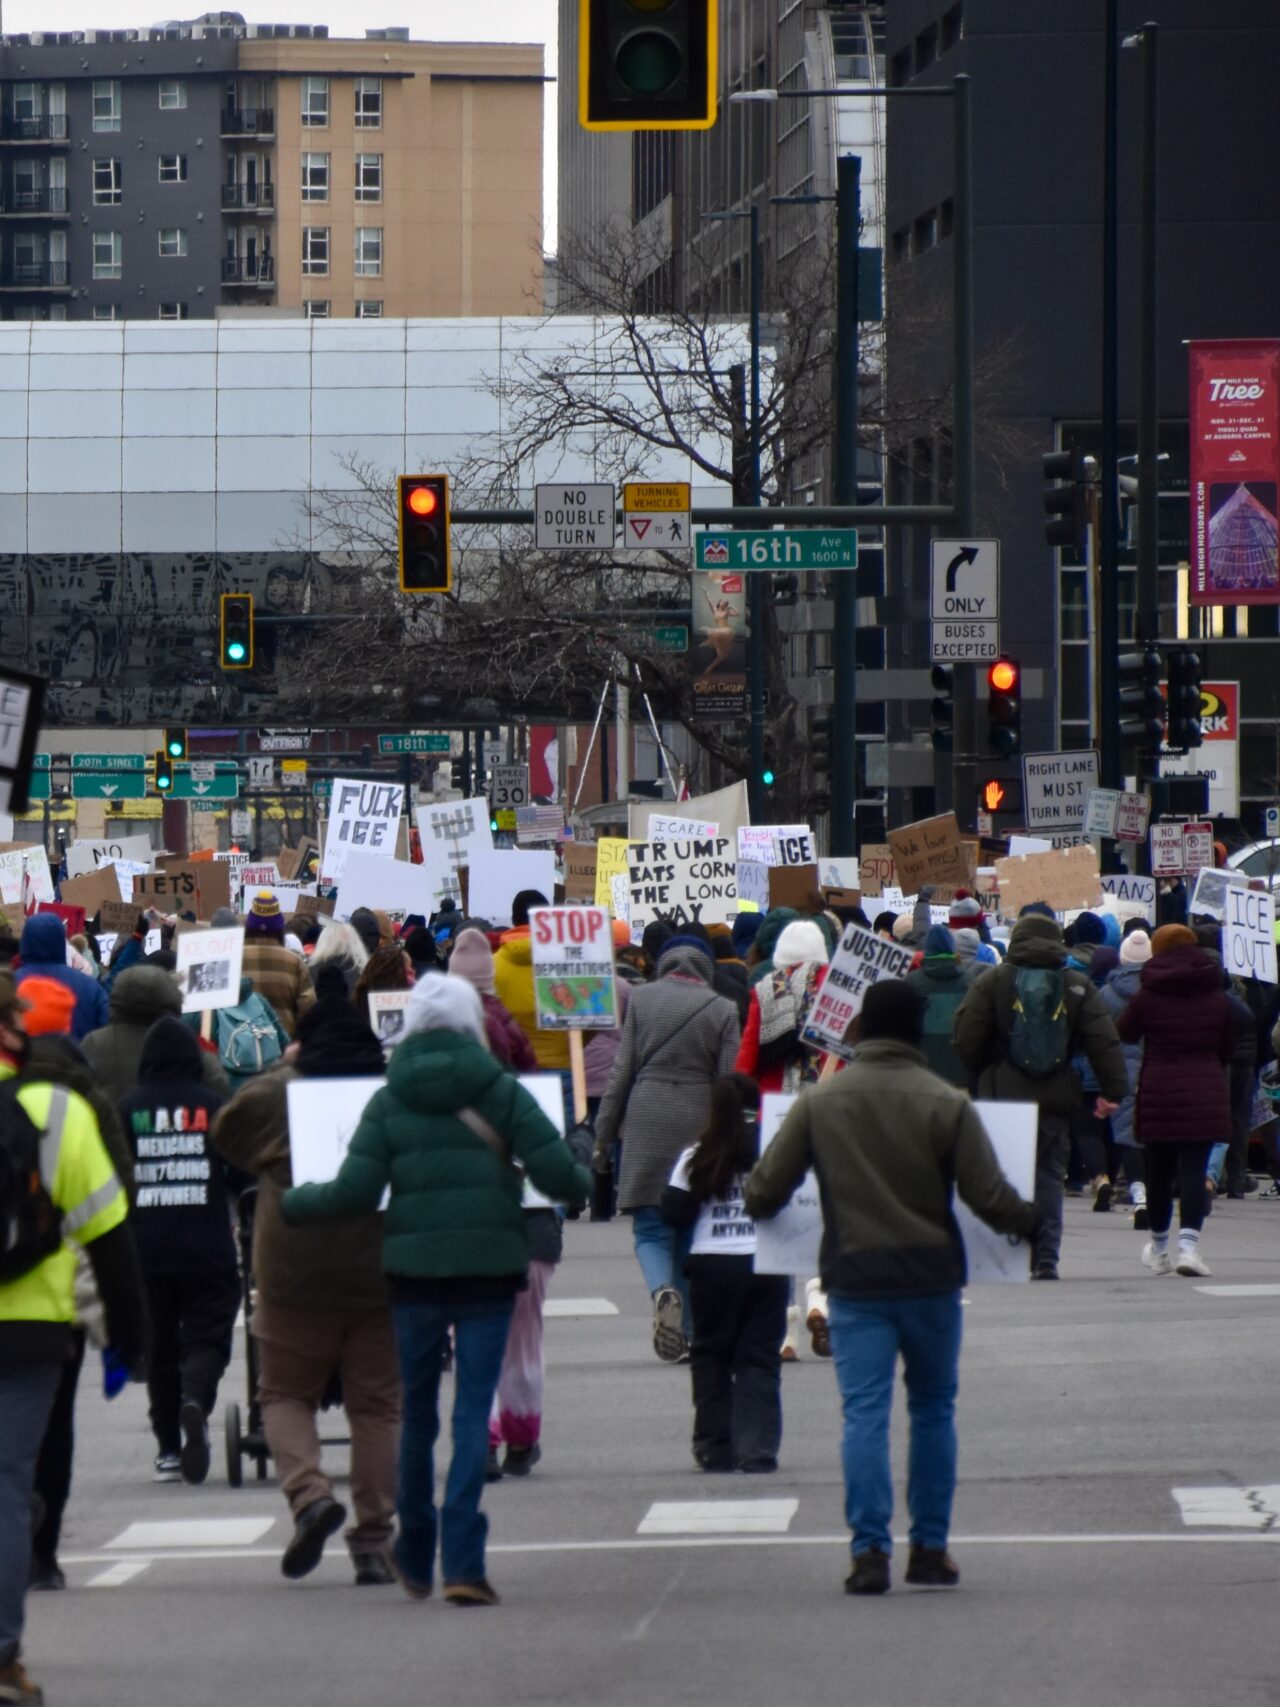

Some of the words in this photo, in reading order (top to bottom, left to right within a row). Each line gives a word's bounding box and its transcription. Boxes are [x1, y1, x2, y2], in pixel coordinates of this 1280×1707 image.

[1210, 378, 1265, 401] Tree
[564, 490, 586, 505] NO
[636, 487, 680, 497] TURNING
[633, 498, 682, 508] VEHICLES
[545, 510, 606, 525] DOUBLE
[555, 529, 596, 544] TURN
[654, 526, 663, 534] TO
[736, 536, 802, 563] 16th
[821, 537, 842, 547] Ave
[811, 551, 838, 562] 1600
[842, 551, 851, 561] N
[944, 597, 985, 613] ONLY
[945, 625, 985, 638] BUSES
[934, 643, 996, 657] EXCEPTED
[78, 757, 104, 768] 20TH
[107, 757, 138, 768] STREET
[1028, 763, 1062, 776] RIGHT
[1064, 760, 1094, 773] LANE
[496, 769, 525, 777] SPEED
[499, 778, 521, 787] LIMIT
[1043, 782, 1083, 798] MUST
[337, 784, 403, 818] FUCK
[497, 787, 524, 803] 30
[1128, 796, 1141, 806] NO
[1031, 805, 1060, 819] TURN
[1066, 804, 1084, 817] RIG
[1120, 804, 1147, 816] PARKING
[338, 820, 388, 847] ICE
[667, 823, 705, 836] CARE
[1161, 827, 1173, 837] NO
[895, 839, 916, 856] We
[1052, 835, 1091, 849] USES
[1153, 838, 1182, 848] PARKING
[92, 845, 123, 864] NO
[600, 844, 627, 864] STA
[628, 838, 730, 863] TRUMP
[778, 836, 812, 865] ICE
[1161, 855, 1175, 864] TIME
[569, 865, 596, 875] ILLEG
[629, 864, 675, 884] EATS
[689, 862, 736, 880] CORN
[862, 858, 895, 880] STO
[241, 874, 256, 884] FOR
[631, 885, 670, 904] THE
[685, 883, 737, 901] LONG
[651, 903, 704, 925] WAY
[1230, 890, 1269, 934] ICE
[533, 910, 604, 945] STOP
[564, 947, 583, 960] THE
[842, 930, 913, 978] JUSTICE
[1232, 933, 1271, 974] OUT
[534, 961, 613, 977] DEPORTATIONS
[856, 962, 880, 985] FOR
[828, 968, 865, 996] RENEE
[821, 994, 854, 1019] KILLED
[813, 1009, 827, 1025] BY
[827, 1017, 847, 1034] ICE
[137, 1133, 205, 1157] MEXICANS
[166, 1159, 211, 1181] GOING
[136, 1184, 208, 1208] ANYWHERE
[711, 1223, 756, 1238] ANYWH
